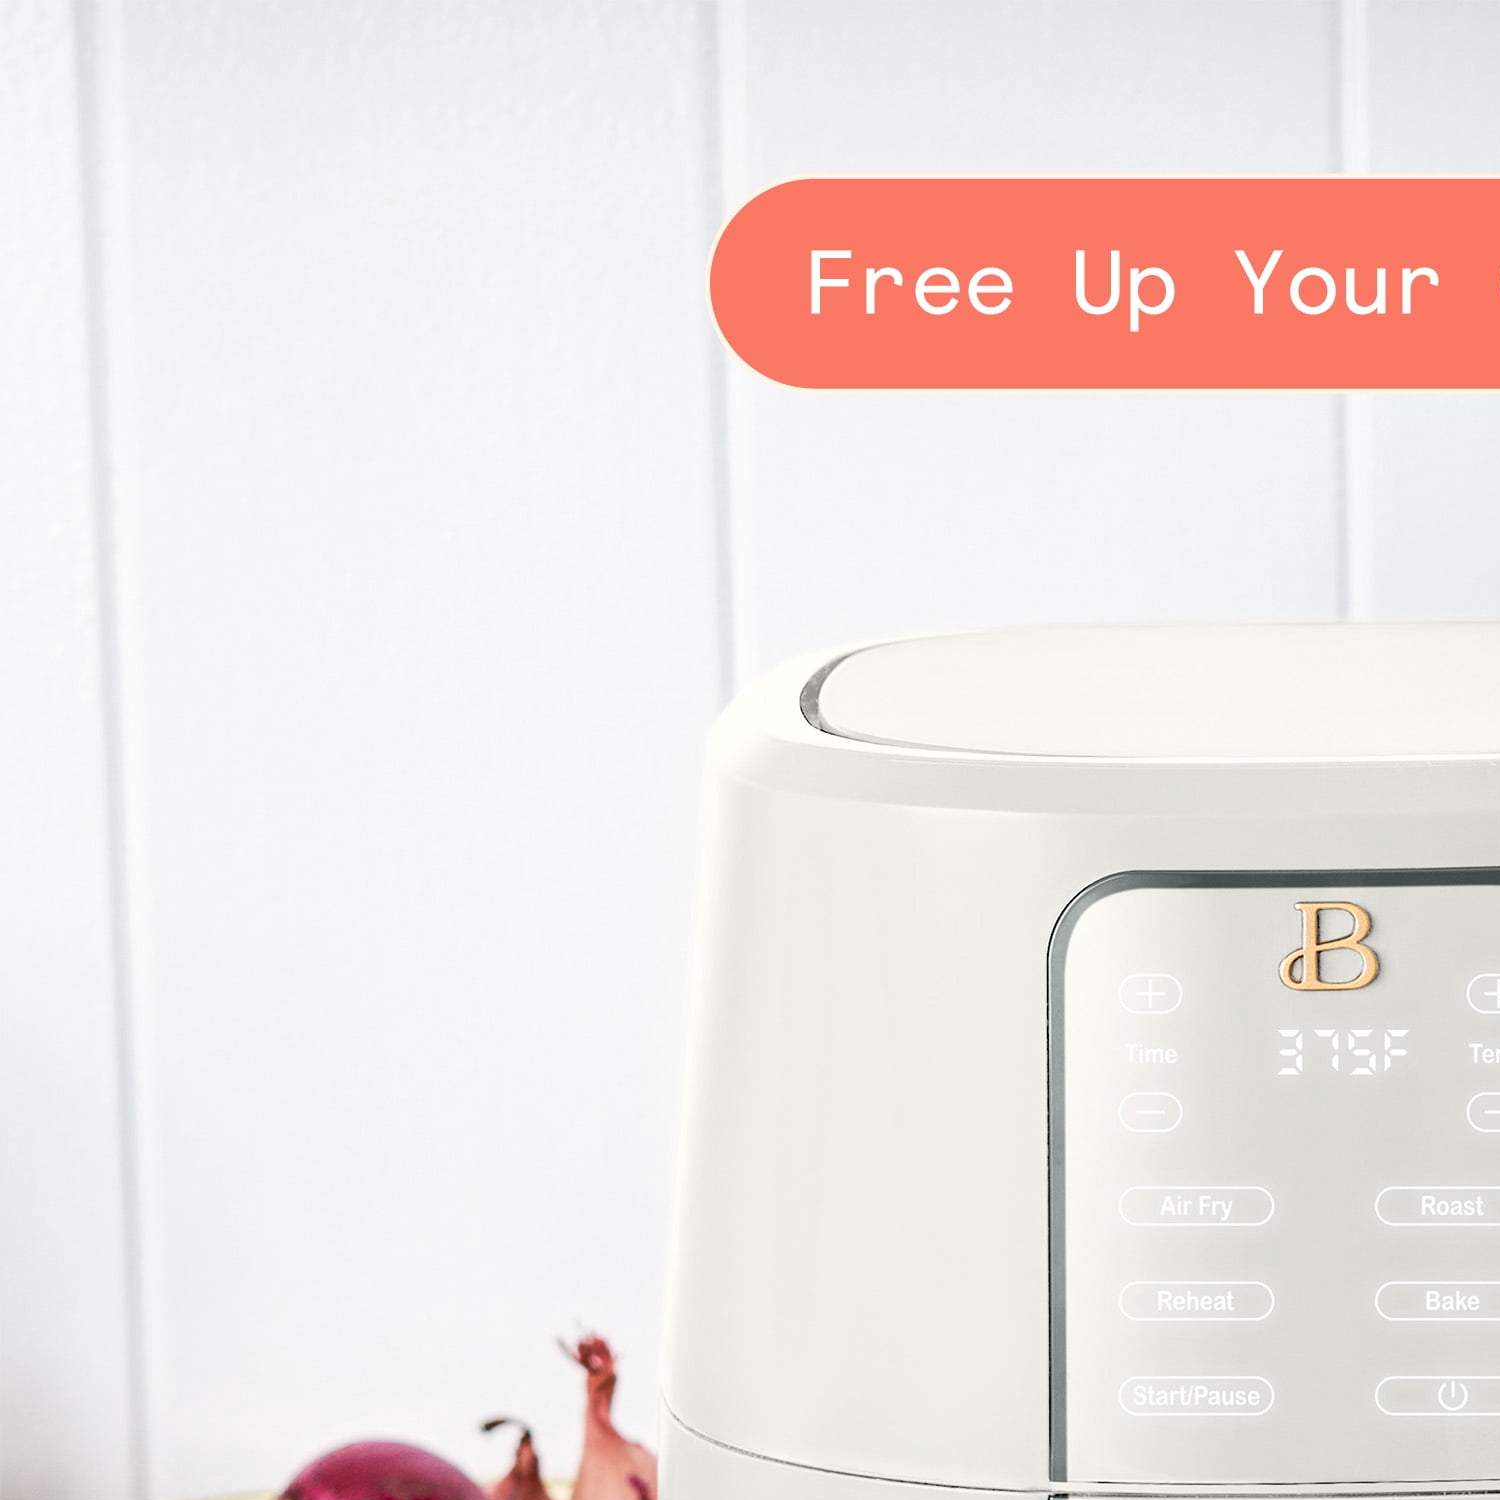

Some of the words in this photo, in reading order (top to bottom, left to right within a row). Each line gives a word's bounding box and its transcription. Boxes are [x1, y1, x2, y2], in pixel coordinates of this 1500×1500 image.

[1123, 1042, 1179, 1065] Time
[1277, 1028, 1410, 1076] 375F
[1159, 1194, 1194, 1217] Air
[1199, 1194, 1234, 1221] Fry
[1420, 1195, 1485, 1217] Roast
[1157, 1290, 1236, 1312] Reheat
[1425, 1290, 1481, 1312] Bake
[1131, 1385, 1261, 1408] Start/Pause
